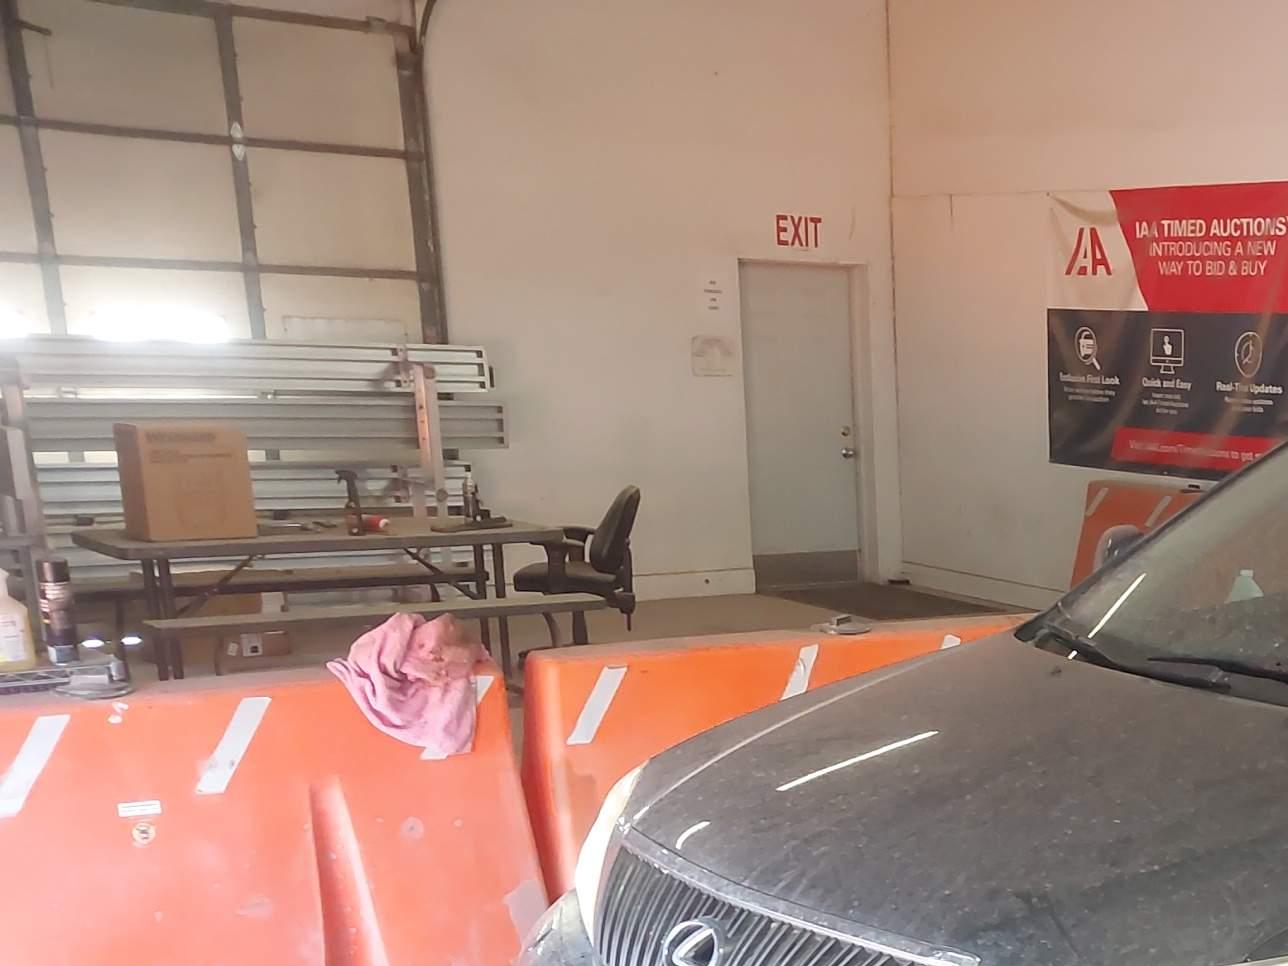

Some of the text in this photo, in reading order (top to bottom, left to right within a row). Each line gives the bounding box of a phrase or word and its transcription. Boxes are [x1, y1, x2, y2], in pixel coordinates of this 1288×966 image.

[775, 214, 822, 248] EXIT
[1135, 220, 1159, 238] IAA
[1160, 218, 1206, 237] TIMED
[1149, 239, 1277, 257] INTRODUCING A NEW
[1158, 259, 1268, 276] WAY TO BID & BUY
[1101, 375, 1121, 385] Look
[1175, 378, 1193, 392] Easy
[1249, 383, 1284, 395] Updates
